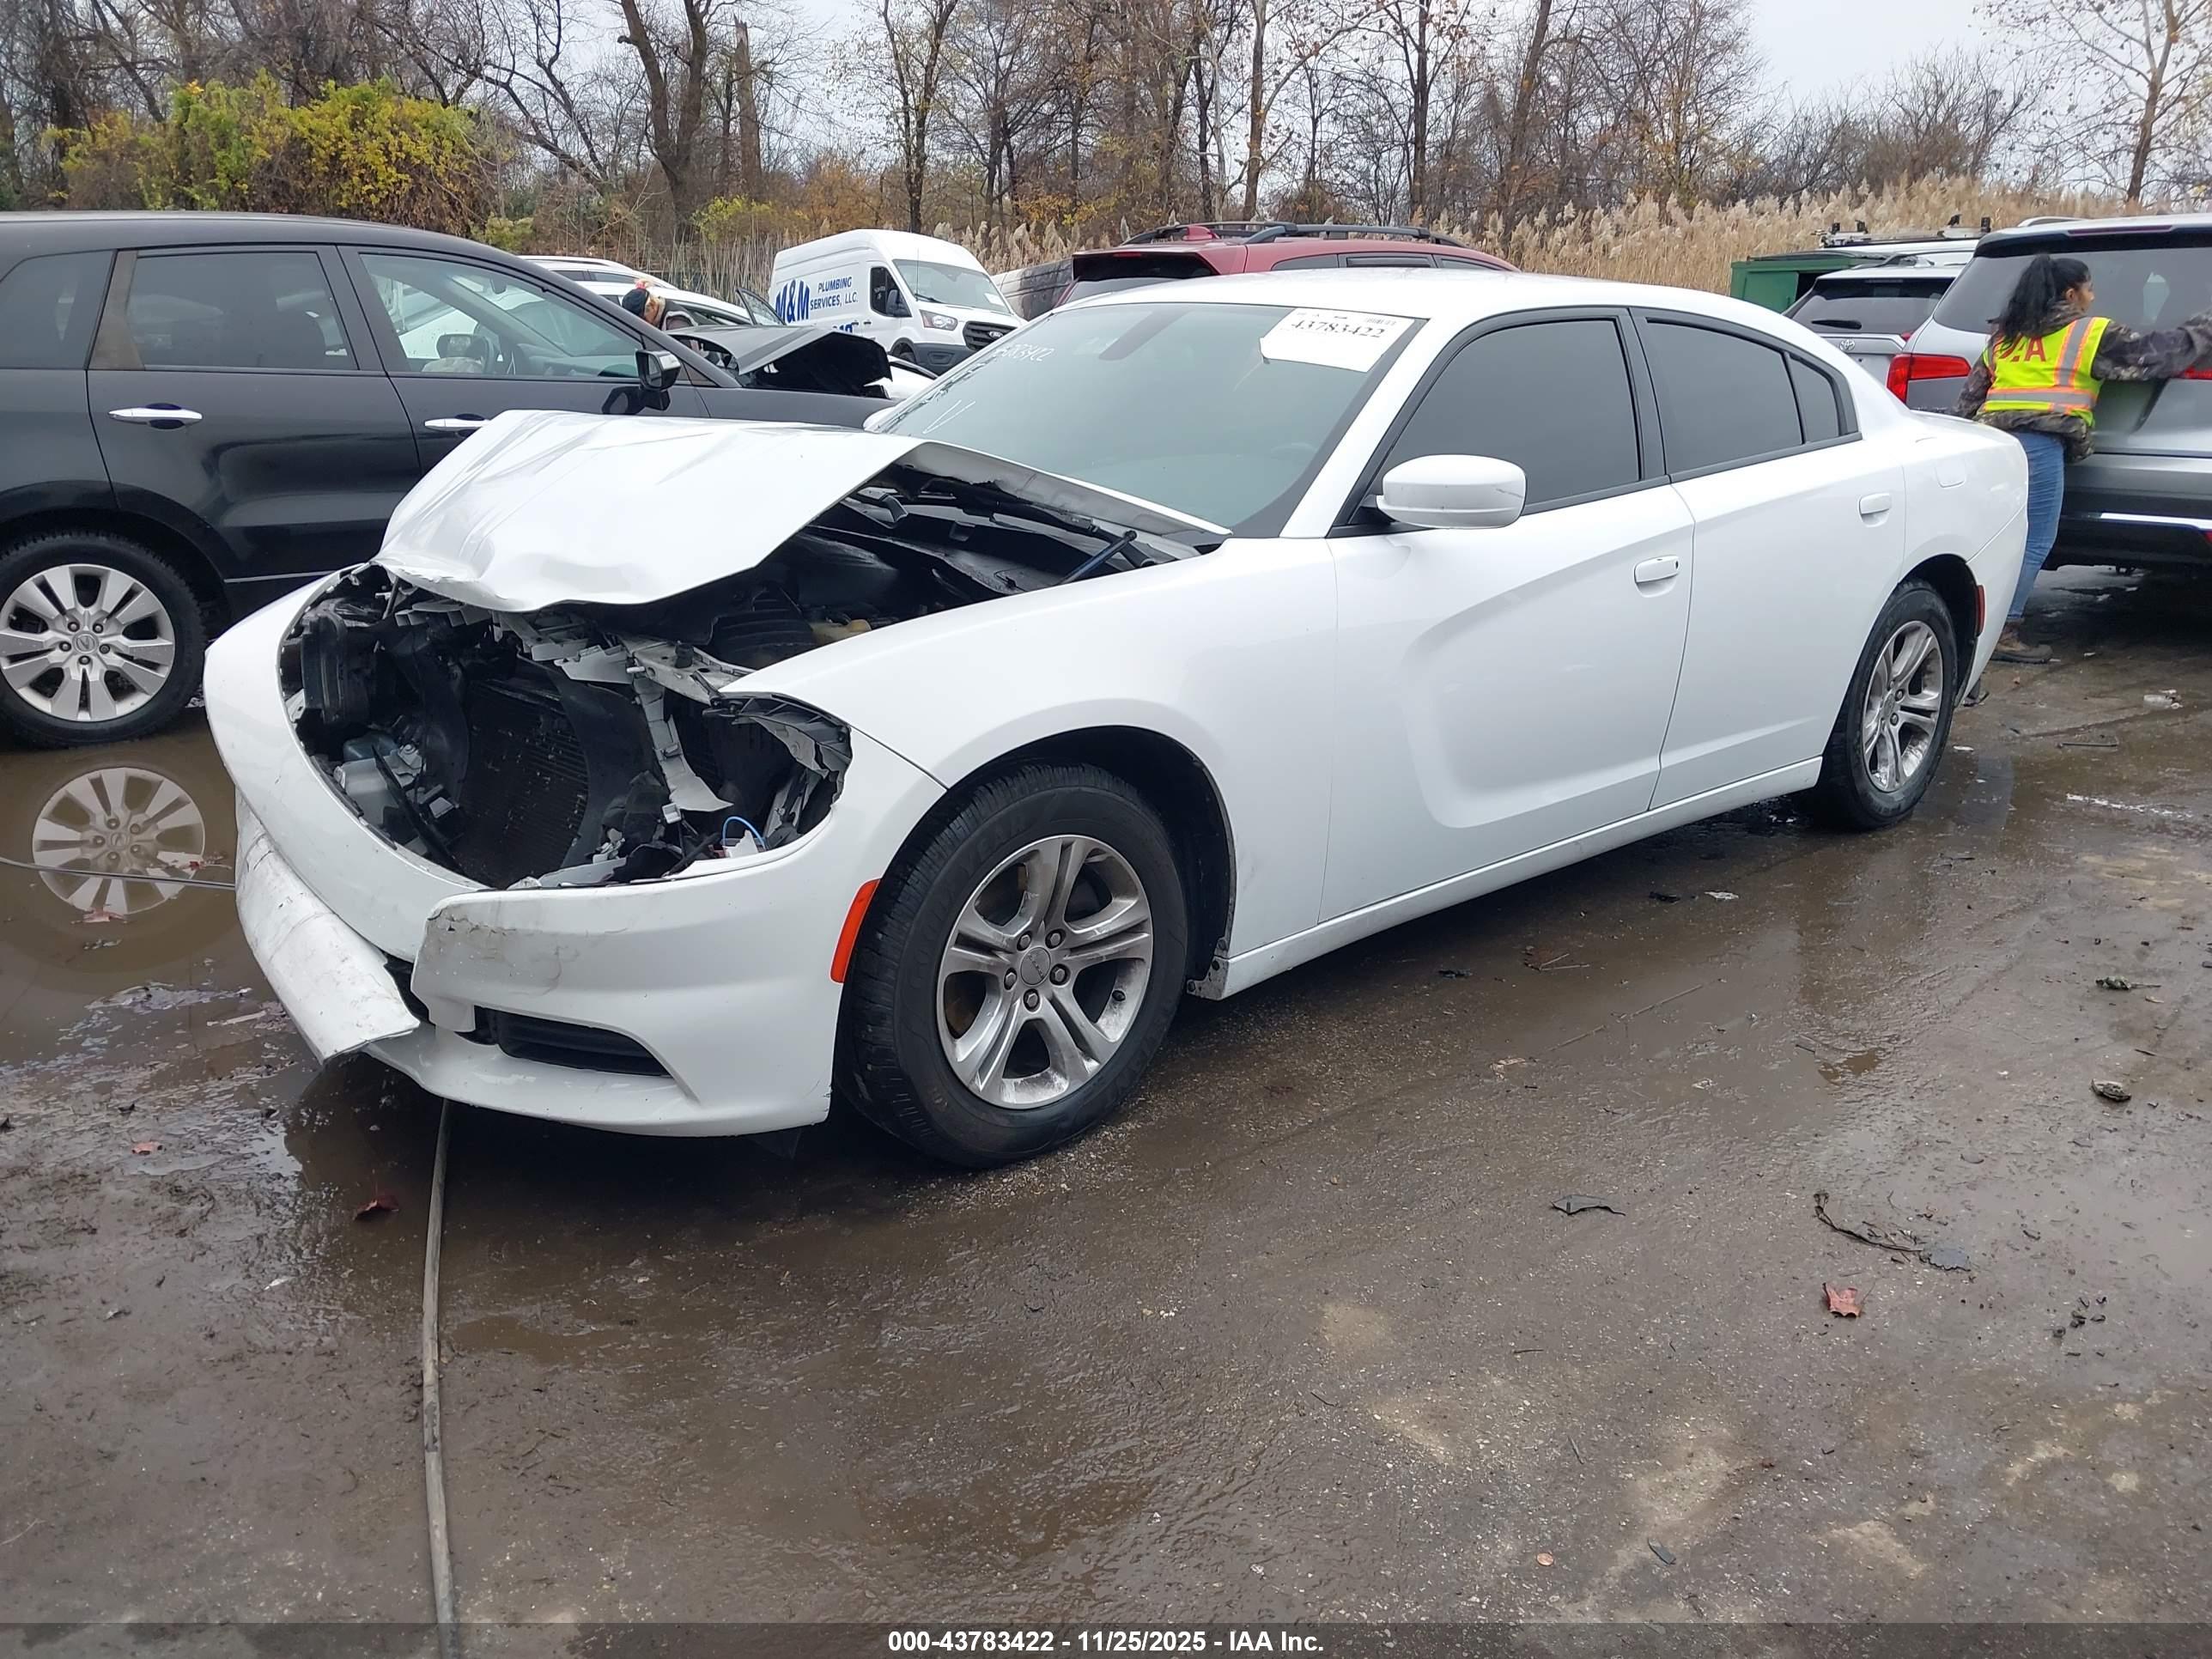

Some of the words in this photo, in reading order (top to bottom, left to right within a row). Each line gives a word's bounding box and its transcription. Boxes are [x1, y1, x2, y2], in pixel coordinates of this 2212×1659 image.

[818, 276, 853, 294] PLUMBING
[775, 279, 811, 325] M&M
[810, 294, 842, 311] SERVICES,
[1291, 319, 1386, 338] 43783422
